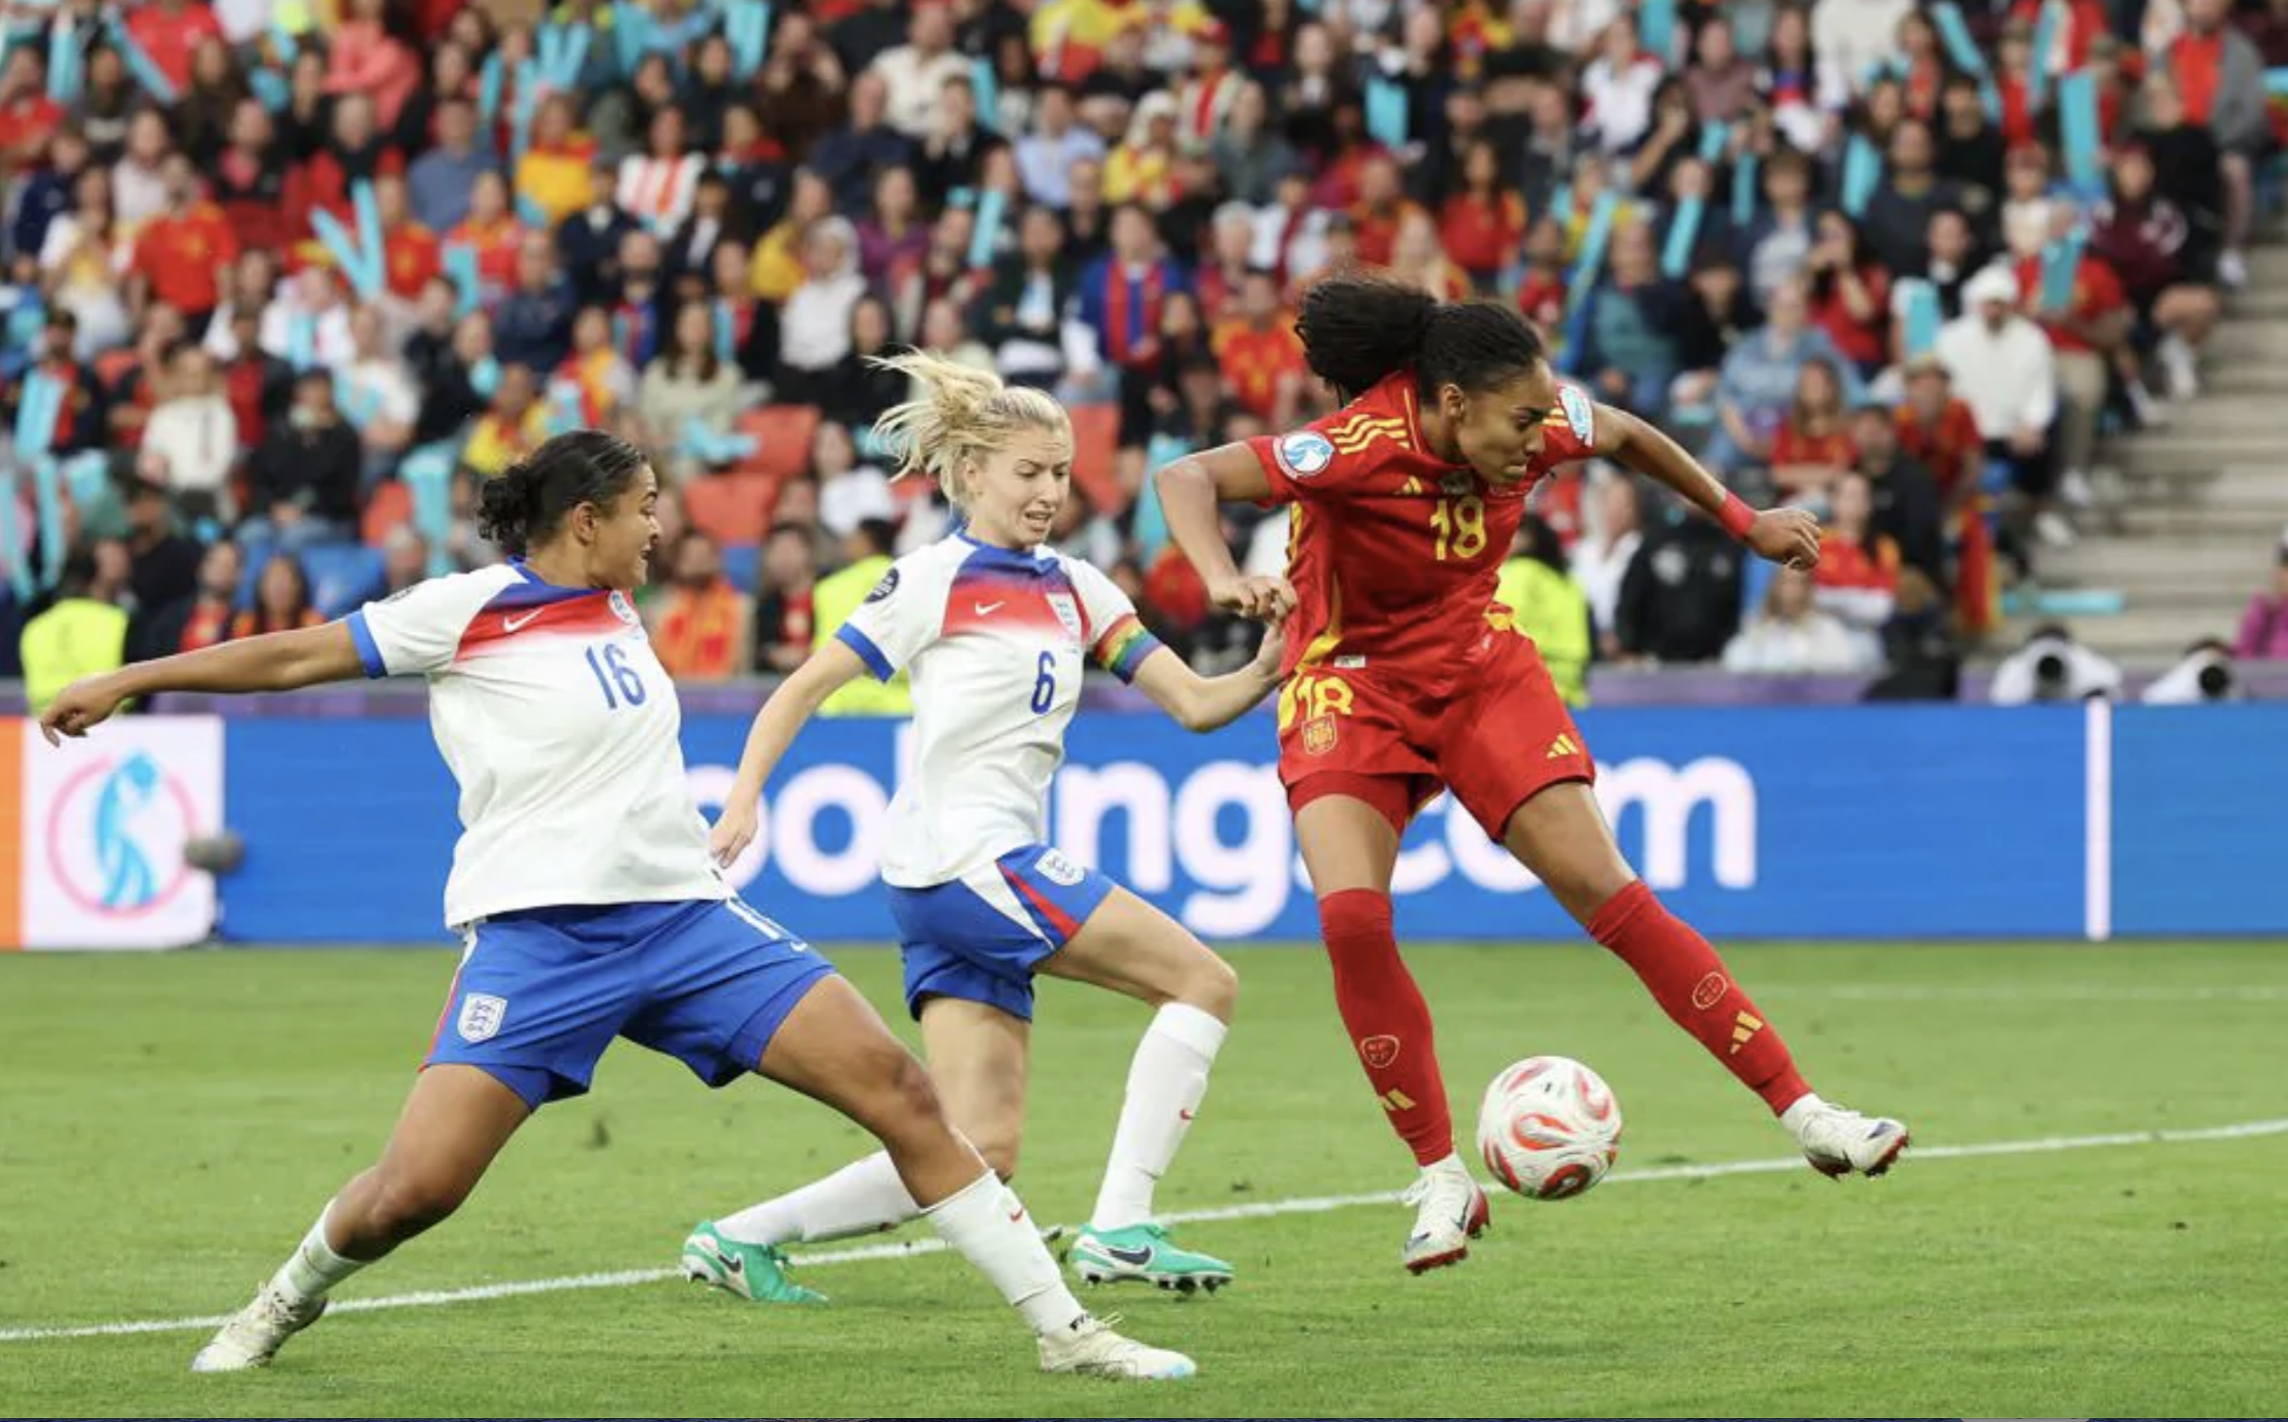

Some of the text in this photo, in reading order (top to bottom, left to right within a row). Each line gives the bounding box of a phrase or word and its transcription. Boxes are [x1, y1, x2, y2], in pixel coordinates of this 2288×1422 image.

[1430, 496, 1487, 560] 18
[585, 643, 646, 709] 16
[1031, 650, 1056, 715] 6
[684, 722, 1757, 936] oongom
